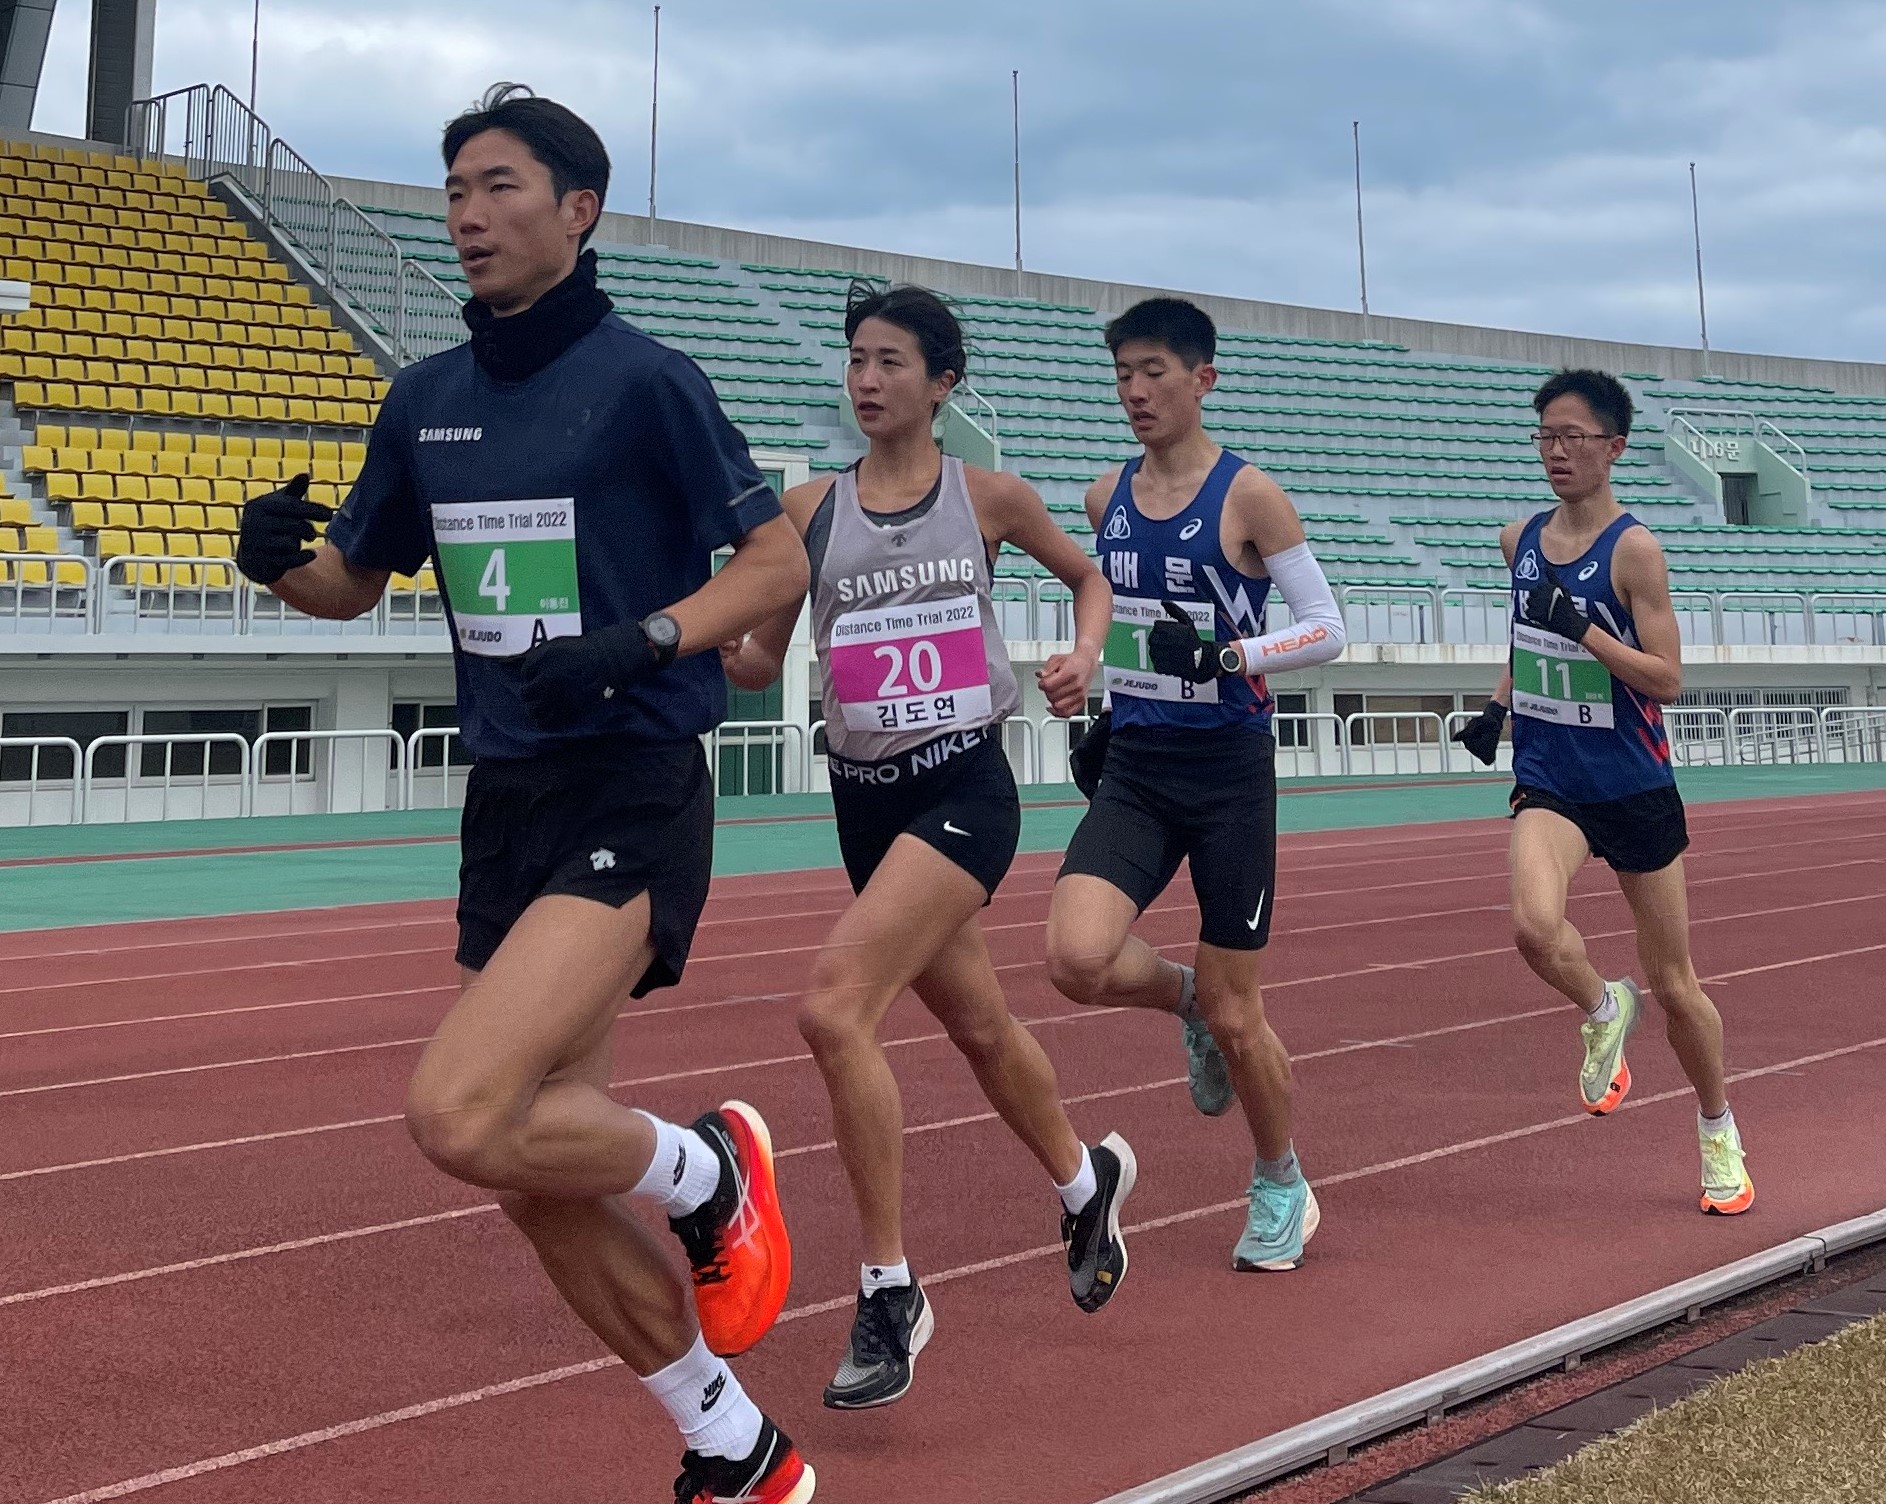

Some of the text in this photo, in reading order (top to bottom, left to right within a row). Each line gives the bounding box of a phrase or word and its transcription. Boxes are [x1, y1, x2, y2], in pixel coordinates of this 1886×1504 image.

[418, 427, 483, 442] SAMSUNG
[477, 514, 505, 530] Time
[508, 512, 533, 528] Trial
[536, 510, 567, 527] 2022
[478, 548, 511, 612] 4
[837, 558, 975, 602] SAMSUNG
[835, 605, 975, 637] Distance Time Trial 2022
[1140, 606, 1162, 618] Time
[530, 617, 549, 648] A
[1261, 626, 1328, 656] HEAD
[1131, 628, 1148, 670] 1
[873, 640, 943, 698] 20
[1124, 678, 1158, 691] JEJUDO
[1536, 658, 1571, 700] 11
[1180, 677, 1195, 699] B
[877, 695, 956, 729] 김도연
[1578, 704, 1593, 724] B
[842, 763, 900, 785] PRO
[911, 730, 981, 776] NIKE
